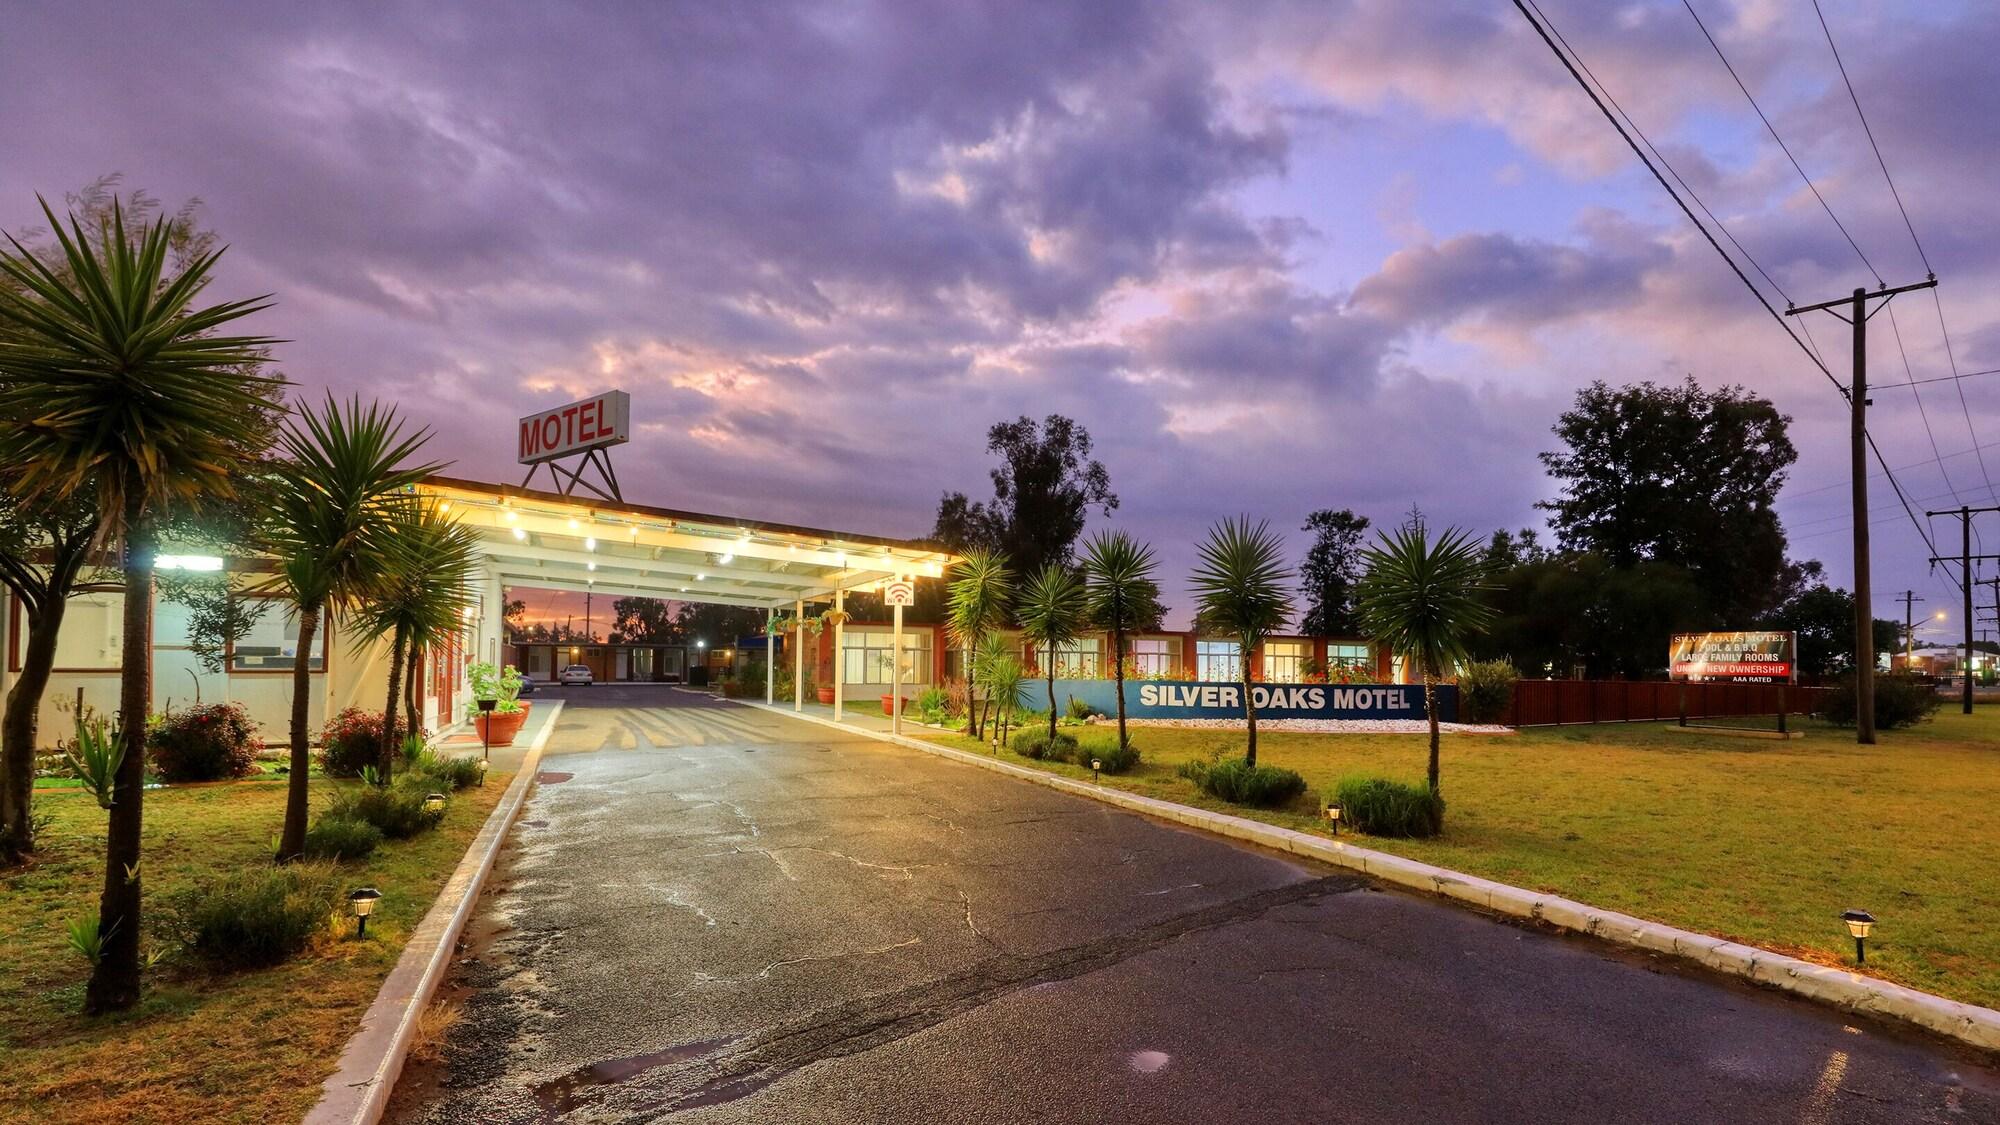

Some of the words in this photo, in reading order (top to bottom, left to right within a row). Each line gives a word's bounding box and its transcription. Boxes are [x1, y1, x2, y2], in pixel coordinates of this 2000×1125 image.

[521, 400, 613, 458] MOTEL
[1725, 643, 1731, 652] &
[1734, 643, 1758, 652] B.B.Q
[1681, 653, 1708, 662] LARGE
[1710, 653, 1743, 662] FAMILY
[1744, 653, 1779, 662] ROOMS
[1676, 665, 1706, 673] UNR
[1708, 665, 1727, 673] NEW
[1729, 665, 1785, 674] OWNERSHIP
[1140, 684, 1239, 708] SILVER
[1251, 686, 1326, 710] OAKS
[1333, 688, 1411, 710] MOTEL
